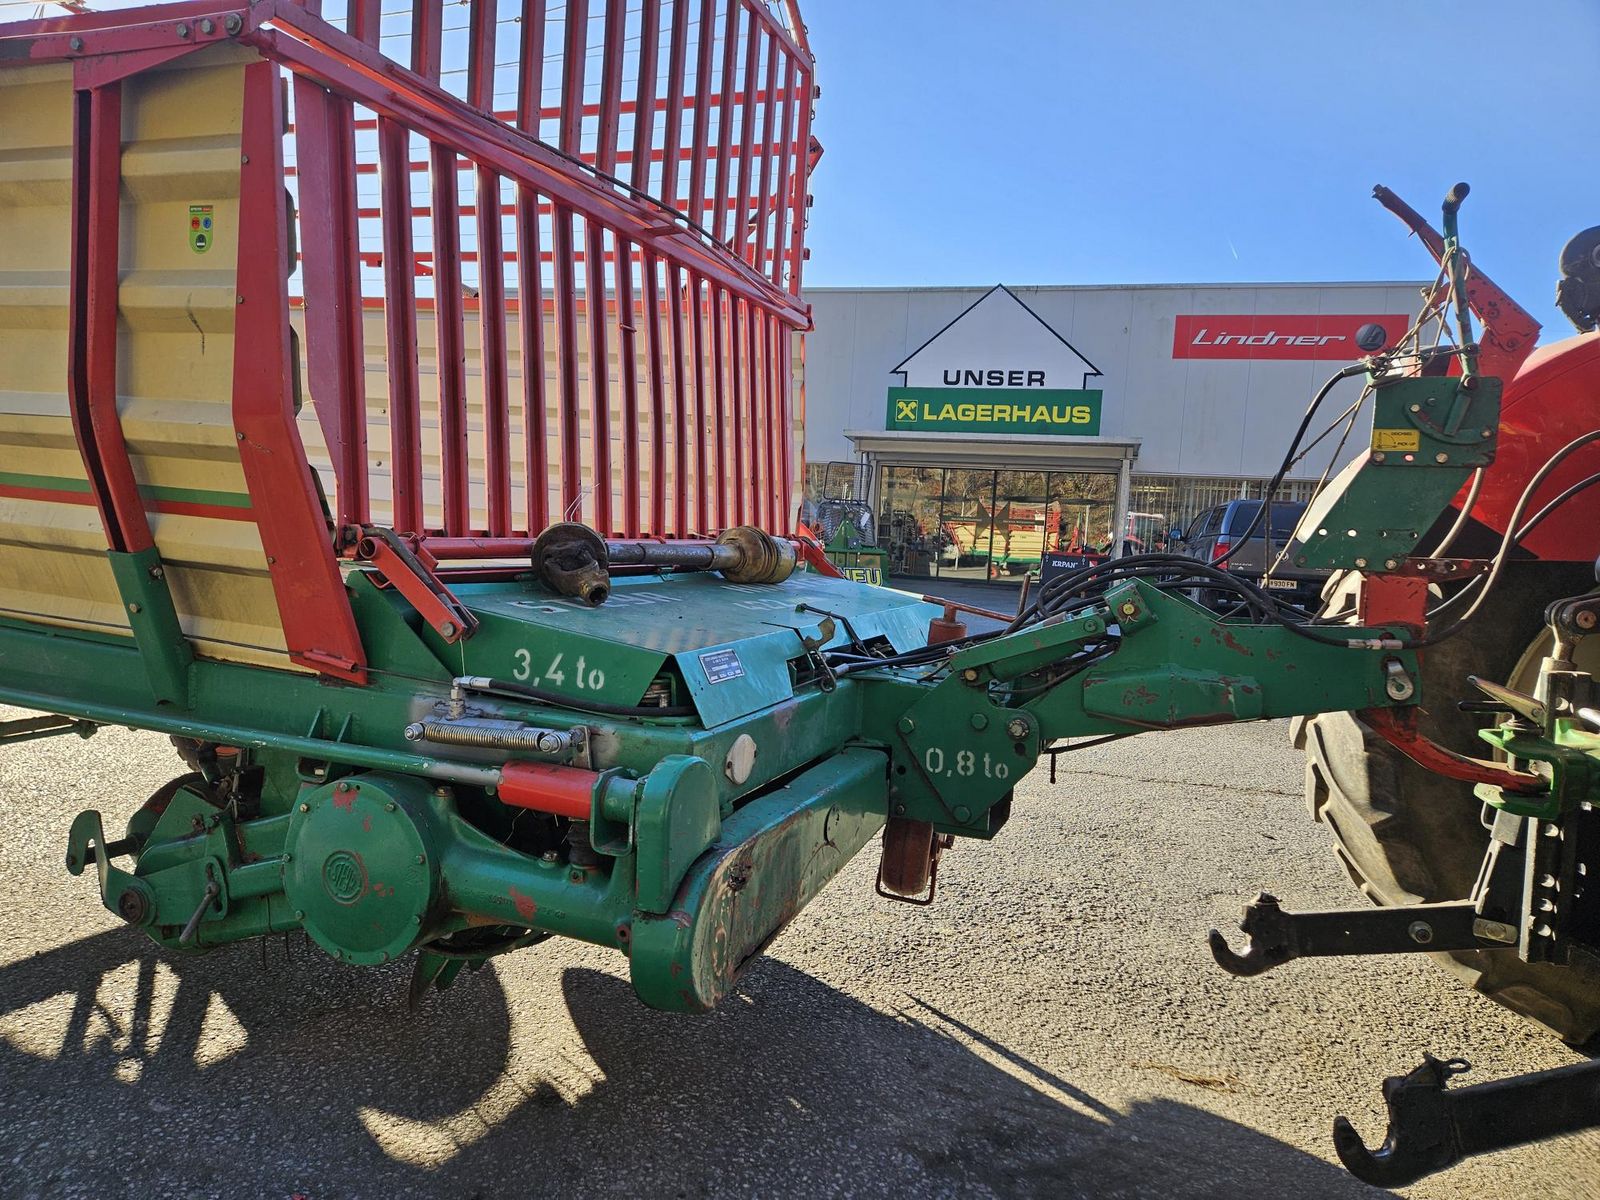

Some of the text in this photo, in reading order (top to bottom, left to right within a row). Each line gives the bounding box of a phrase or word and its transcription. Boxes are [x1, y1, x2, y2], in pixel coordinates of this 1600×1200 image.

[1192, 329, 1346, 345] Lindner
[943, 370, 1045, 387] UNSER
[923, 404, 1091, 424] LAGERHAUS
[1052, 560, 1076, 568] KRPAN
[513, 648, 605, 690] 3,4 to
[926, 747, 1009, 778] 0,8 to
